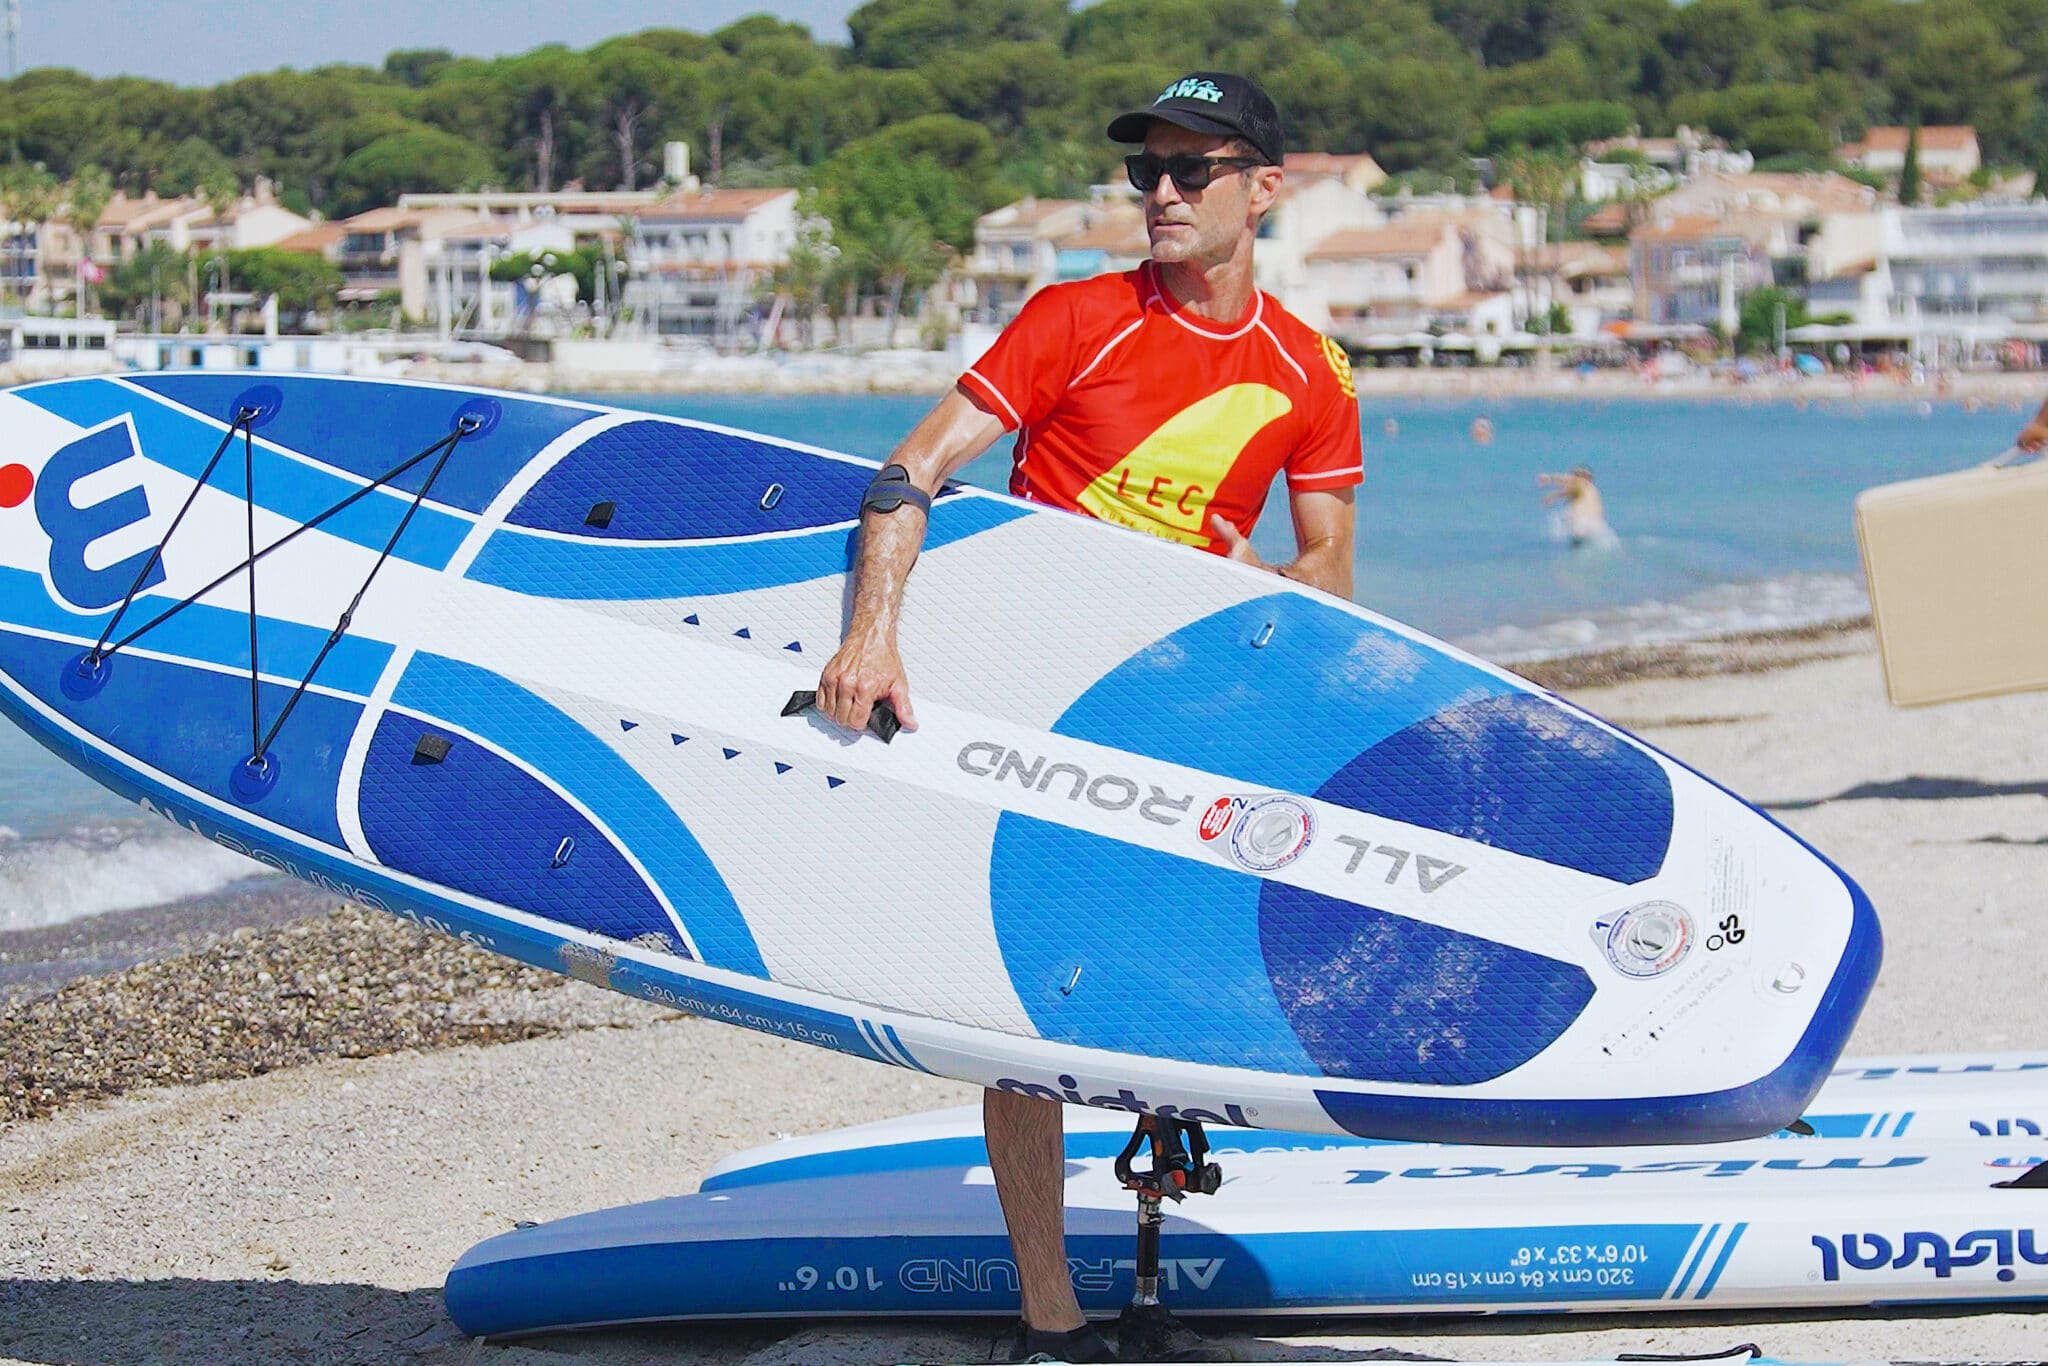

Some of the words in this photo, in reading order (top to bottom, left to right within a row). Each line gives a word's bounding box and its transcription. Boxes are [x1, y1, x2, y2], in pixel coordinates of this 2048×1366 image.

[1117, 468, 1203, 515] LEC
[956, 740, 1195, 826] ROUND
[1334, 834, 1469, 895] ALL
[641, 983, 676, 1004] 320
[678, 994, 706, 1012] cm
[719, 1003, 743, 1021] 84
[746, 1013, 774, 1029] cm
[811, 1029, 840, 1045] cm
[1345, 1155, 1931, 1185] mistral
[1511, 1247, 1531, 1266] 6"
[1534, 1246, 1546, 1261] x
[1550, 1245, 1582, 1265] 33"
[900, 1257, 1114, 1292] RUND
[1412, 1272, 1442, 1286] cm
[1447, 1272, 1467, 1289] 15
[1472, 1272, 1481, 1284] x
[1486, 1271, 1516, 1284] cm
[1520, 1270, 1544, 1287] 84
[1549, 1271, 1558, 1282] x
[1563, 1270, 1593, 1283] cm
[1597, 1268, 1635, 1286] 320
